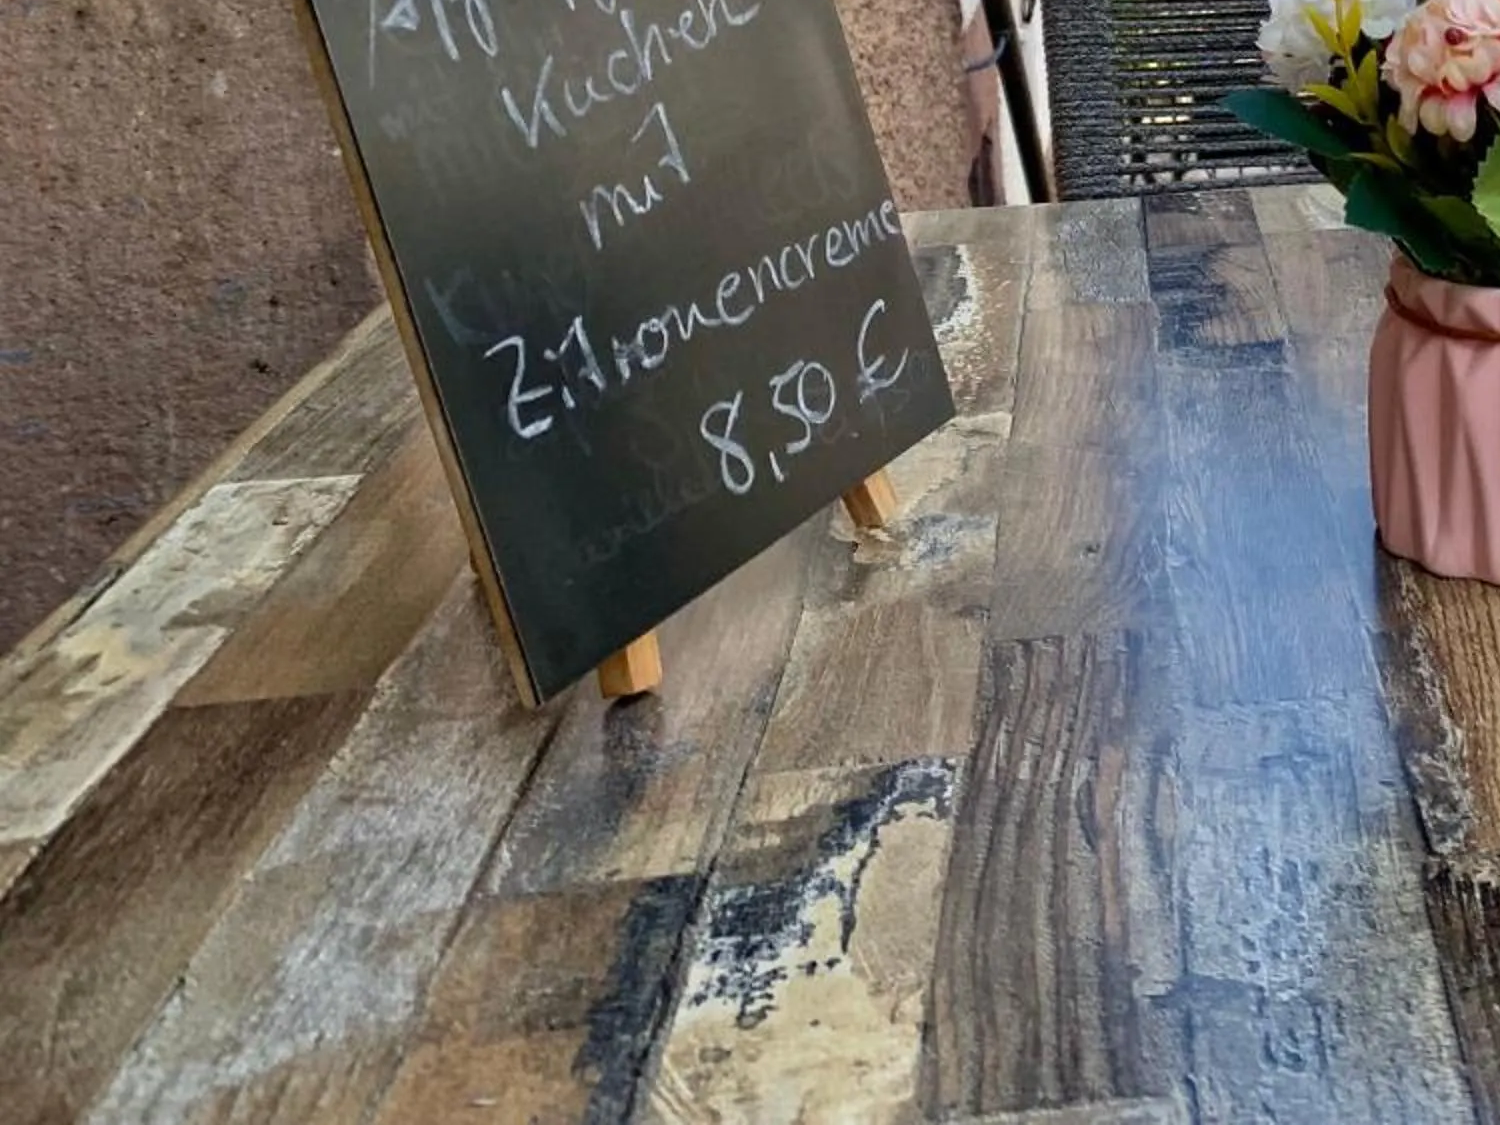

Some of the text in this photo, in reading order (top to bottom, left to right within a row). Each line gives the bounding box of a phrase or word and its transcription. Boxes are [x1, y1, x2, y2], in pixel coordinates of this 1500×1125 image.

[578, 101, 692, 251] mit
[699, 299, 910, 497] 8,50 €
